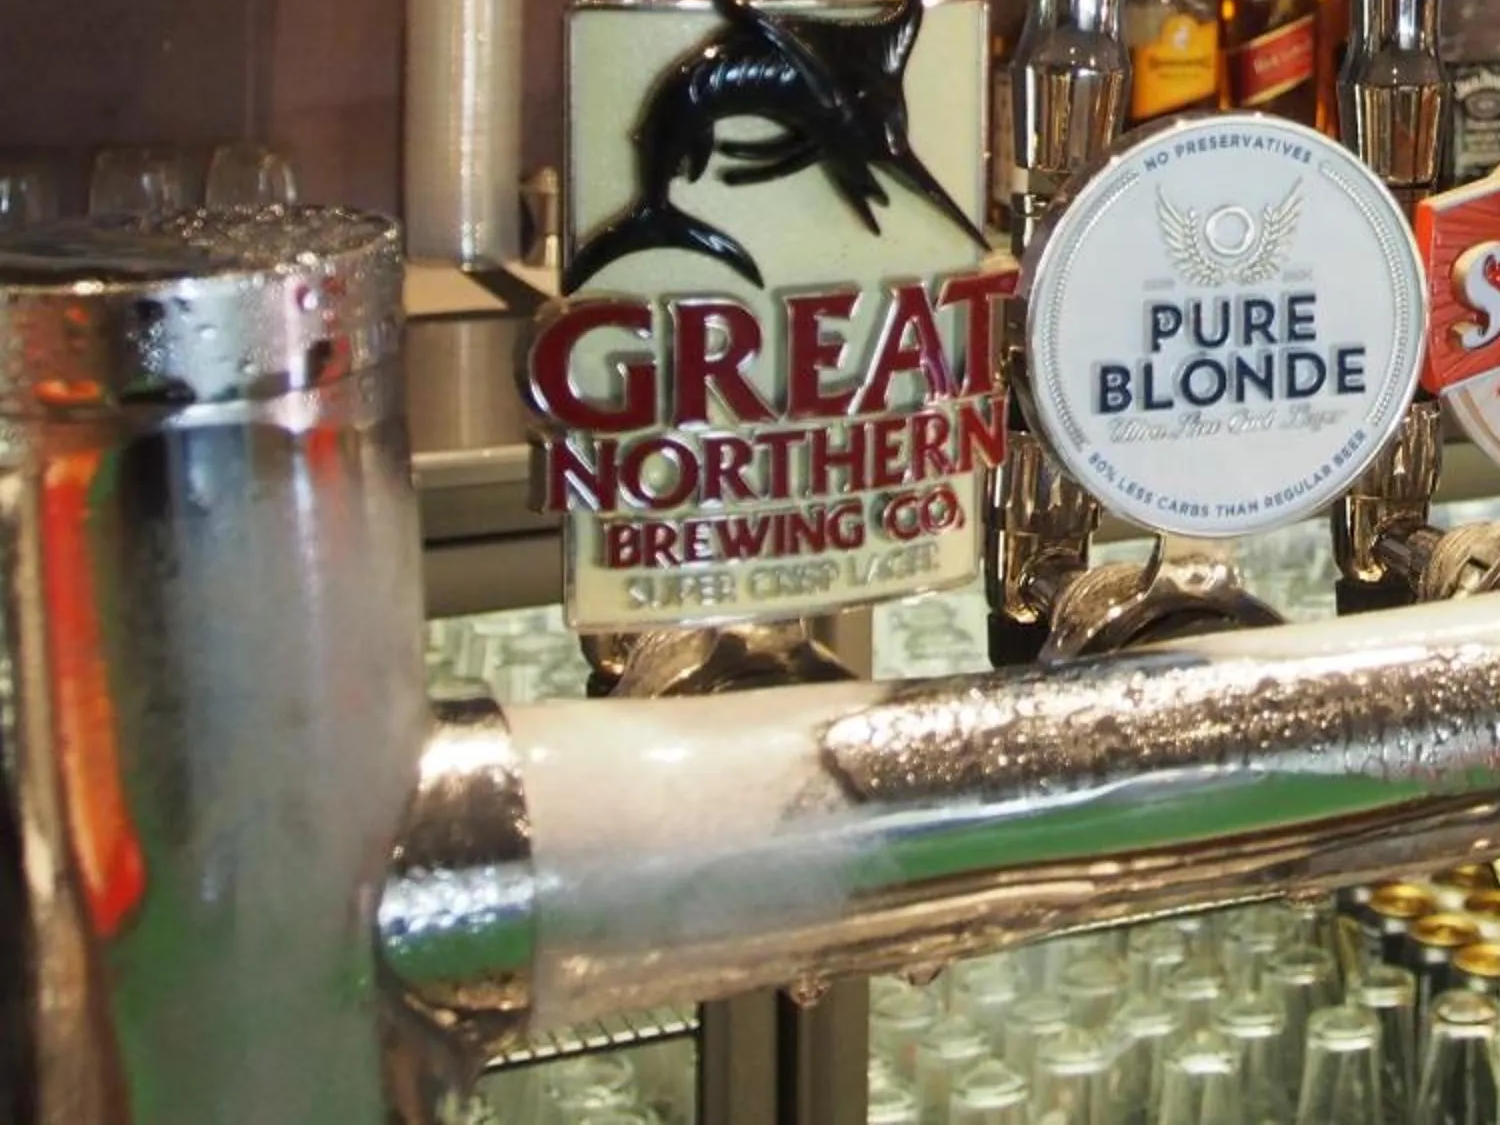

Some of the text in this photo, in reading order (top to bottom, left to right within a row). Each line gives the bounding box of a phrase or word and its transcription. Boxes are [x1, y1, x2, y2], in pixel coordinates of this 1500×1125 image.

[1143, 133, 1314, 173] NO PRESERVATIVES
[530, 269, 1020, 432] GREAT
[1148, 294, 1317, 354] PURE
[1098, 346, 1367, 415] BLONDE
[547, 395, 1009, 515] NORTHERN
[1117, 475, 1154, 504] LESS
[1157, 496, 1209, 518] CARBS
[1215, 500, 1260, 518] THAN
[1263, 463, 1332, 508] REGULAR
[1333, 426, 1368, 469] BEER
[605, 499, 865, 571] BREWING
